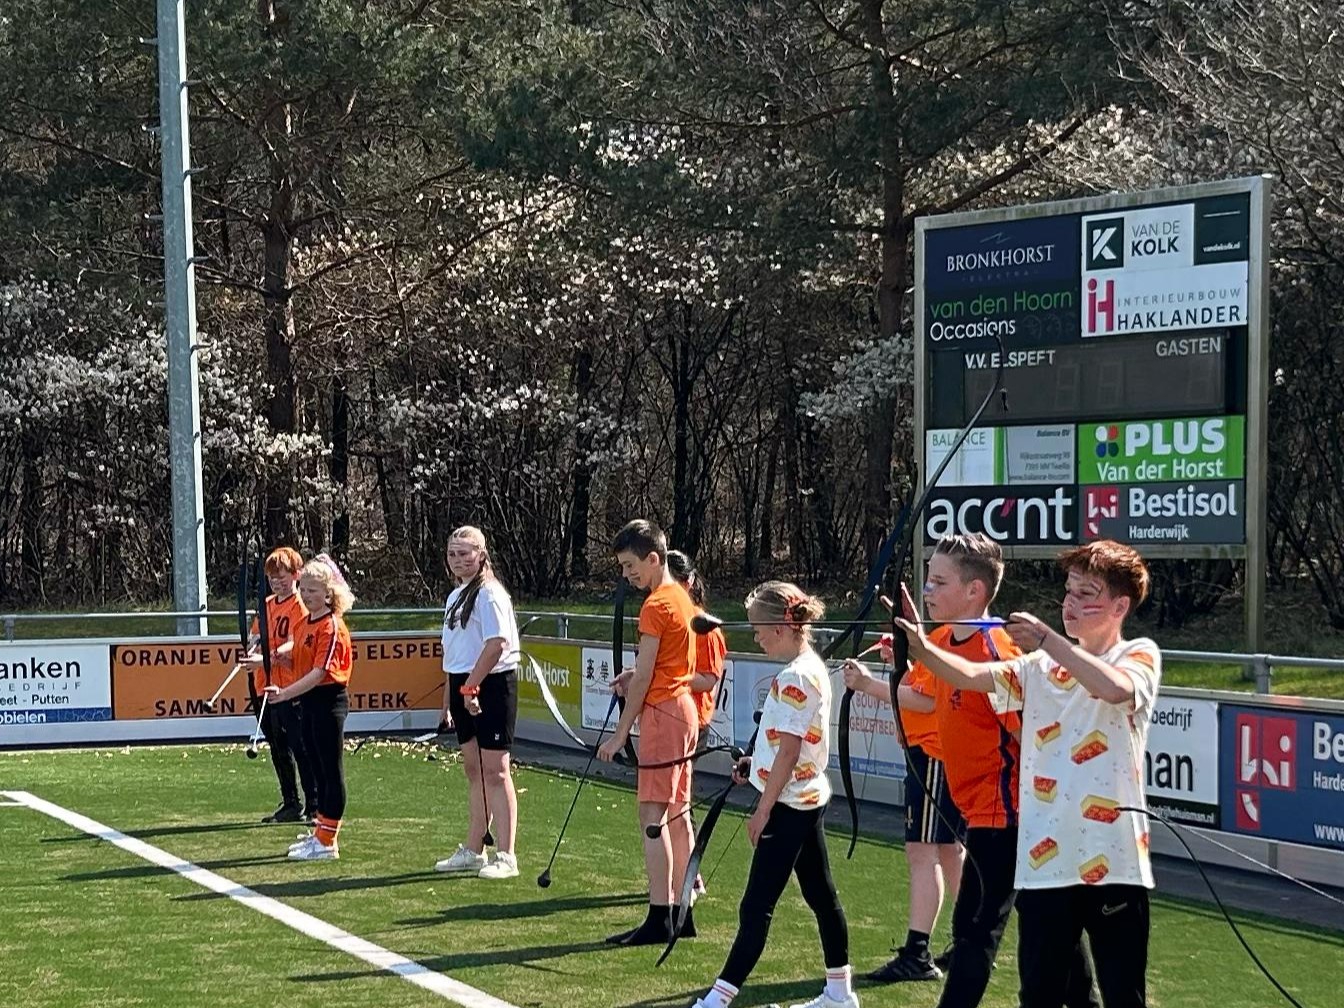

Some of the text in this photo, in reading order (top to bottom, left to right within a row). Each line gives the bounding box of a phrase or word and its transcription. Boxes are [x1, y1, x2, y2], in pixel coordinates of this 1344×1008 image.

[1131, 220, 1181, 238] VAN DE
[946, 244, 1055, 273] BRONKHORST
[1131, 236, 1180, 257] KOLK
[930, 290, 1073, 319] van den Hoorn
[1117, 287, 1242, 307] INTERIEURBOUW
[929, 316, 1017, 342] Occasions
[1117, 304, 1241, 331] HAKLANDER
[1155, 336, 1222, 358] GASTEN
[1124, 418, 1226, 458] PLUS
[1096, 457, 1224, 483] Van der Horst
[1128, 483, 1238, 518] Bestisol
[1128, 523, 1190, 542] Harderwijk
[273, 615, 290, 639] 10
[121, 648, 211, 667] ORANJE
[542, 661, 570, 688] Horst
[31, 693, 70, 706] Putten
[155, 698, 236, 717] SAMEN
[349, 691, 409, 710] TERK
